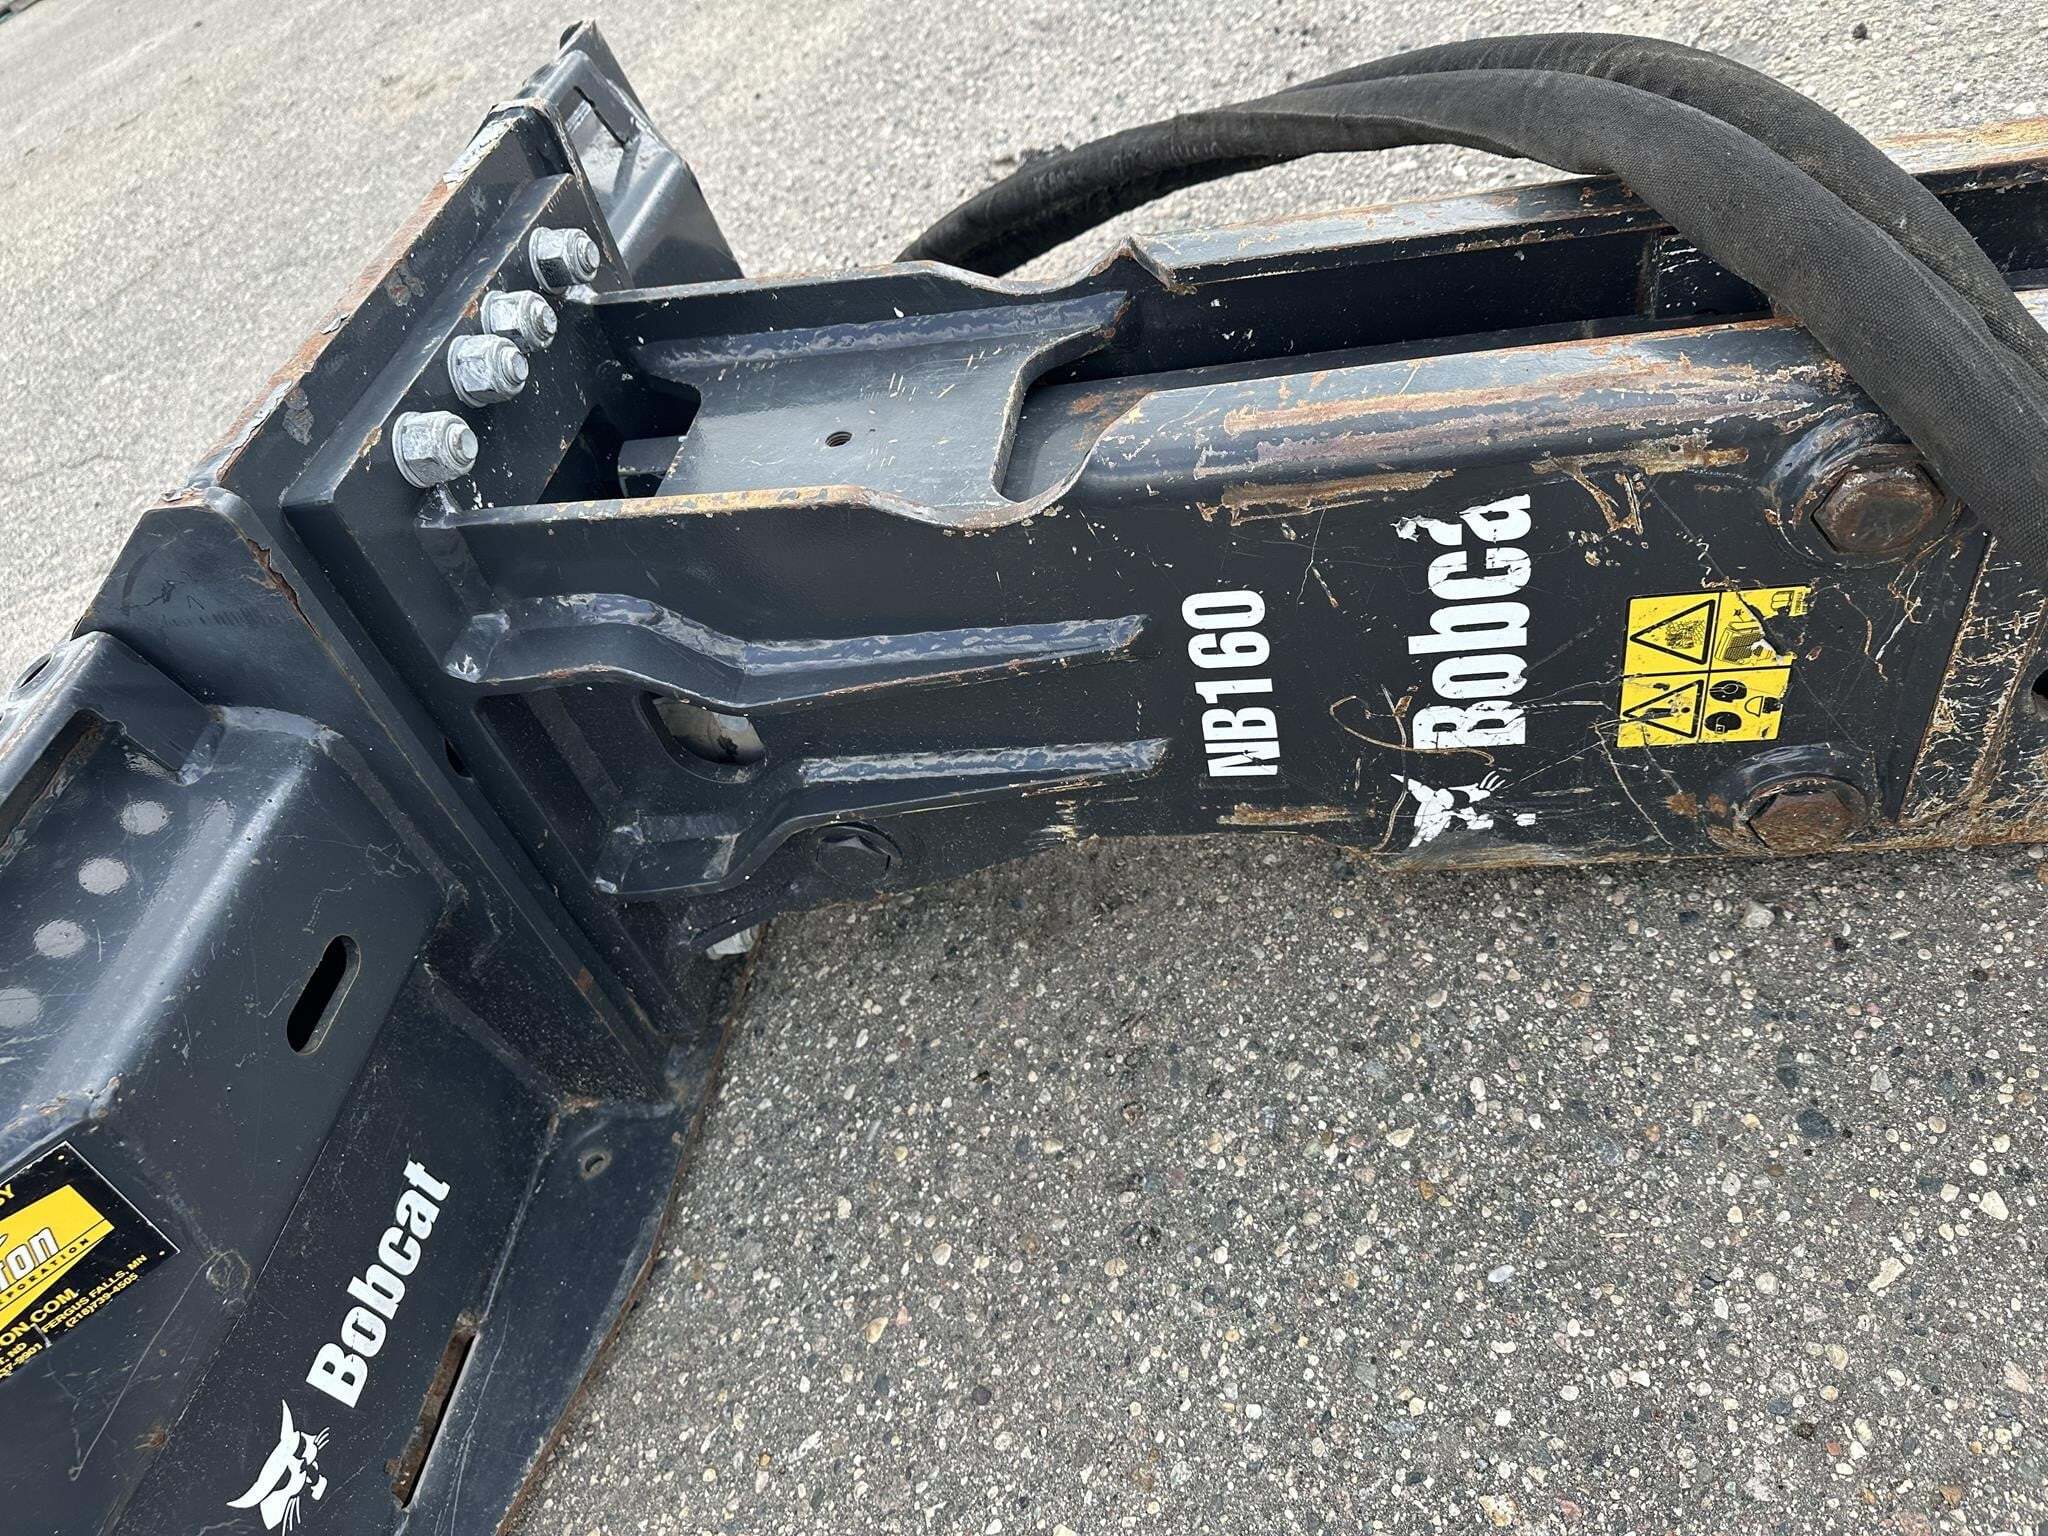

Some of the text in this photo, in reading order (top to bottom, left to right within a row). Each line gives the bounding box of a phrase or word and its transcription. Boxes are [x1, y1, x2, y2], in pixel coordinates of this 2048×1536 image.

[1181, 589, 1282, 778] NB160
[1392, 493, 1533, 749] Bobca
[0, 1238, 89, 1305] PORATION
[41, 1296, 90, 1333] FERGUS
[127, 1254, 148, 1271] MN
[305, 1159, 451, 1409] Bobcat
